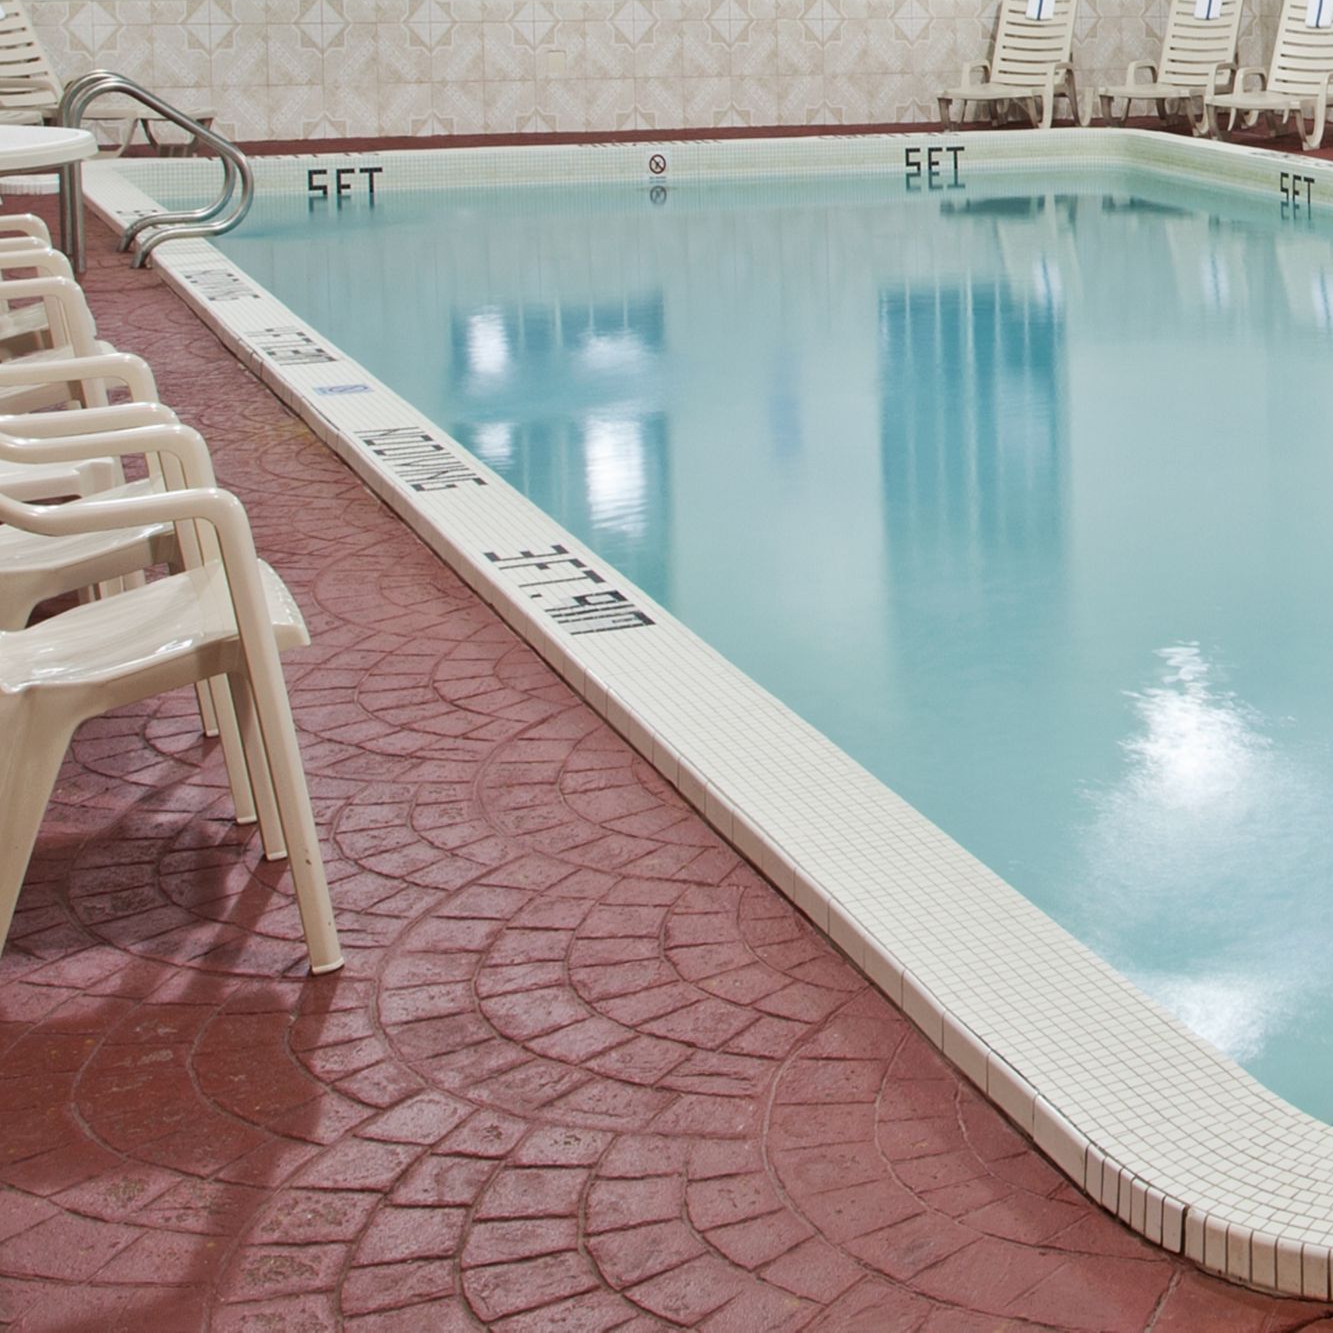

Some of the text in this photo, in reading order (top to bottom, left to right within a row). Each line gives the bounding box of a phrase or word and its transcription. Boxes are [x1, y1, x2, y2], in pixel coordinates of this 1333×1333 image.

[905, 146, 966, 172] 5FT
[307, 167, 383, 196] 5FT
[1280, 172, 1315, 203] 5FT
